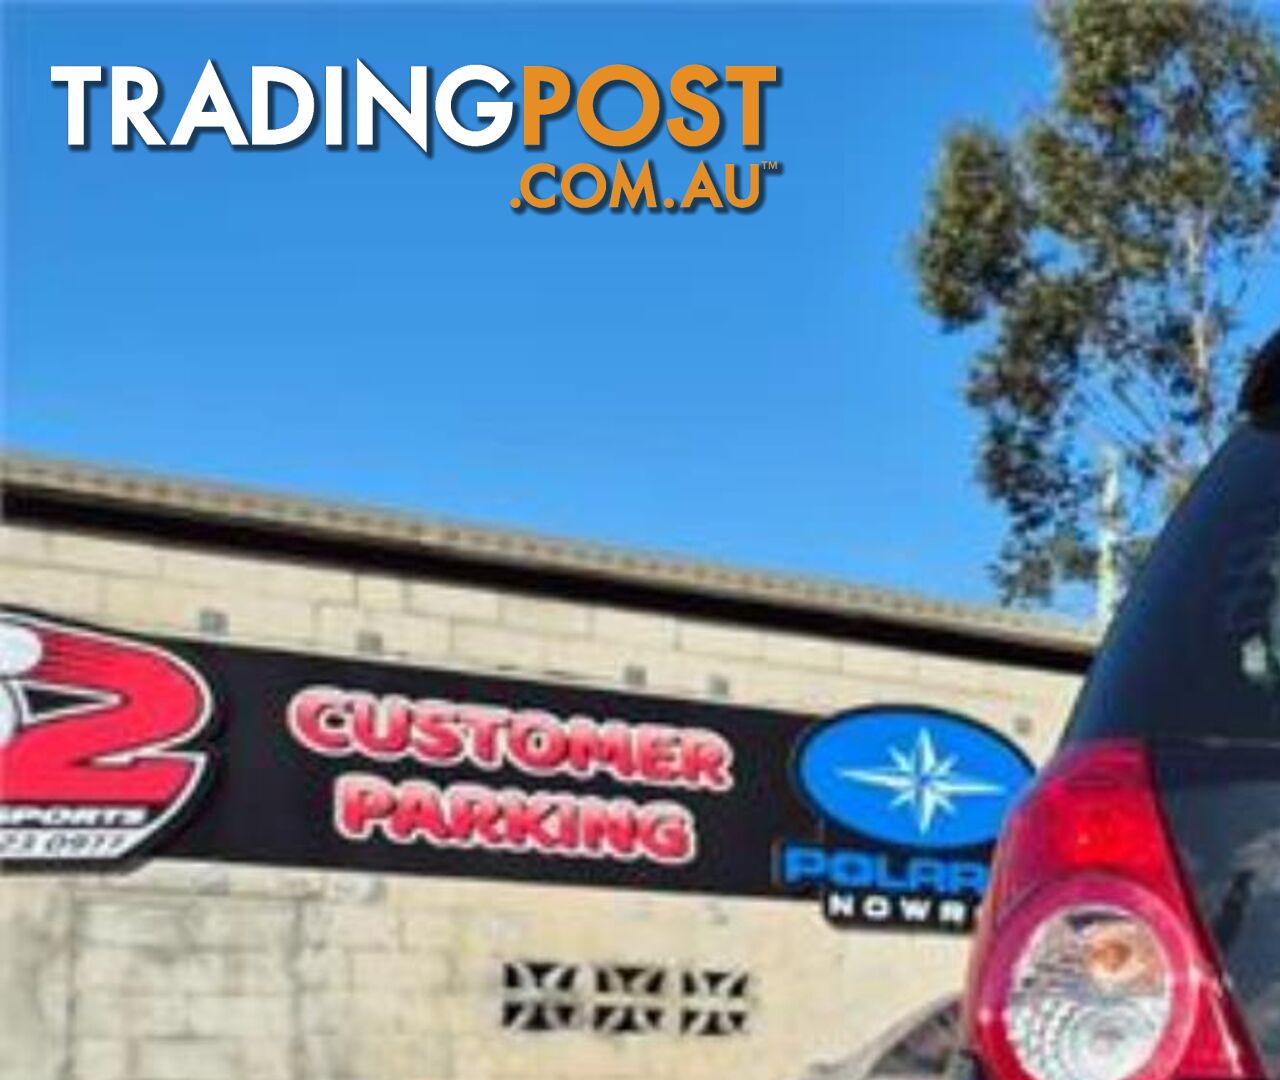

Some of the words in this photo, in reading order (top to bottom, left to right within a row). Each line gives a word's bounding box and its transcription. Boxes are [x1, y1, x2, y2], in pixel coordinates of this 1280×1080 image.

[288, 686, 733, 790] CUSTOMER
[334, 773, 695, 864] PARKING
[784, 845, 992, 895] POLAR
[827, 894, 982, 923] NOWR
